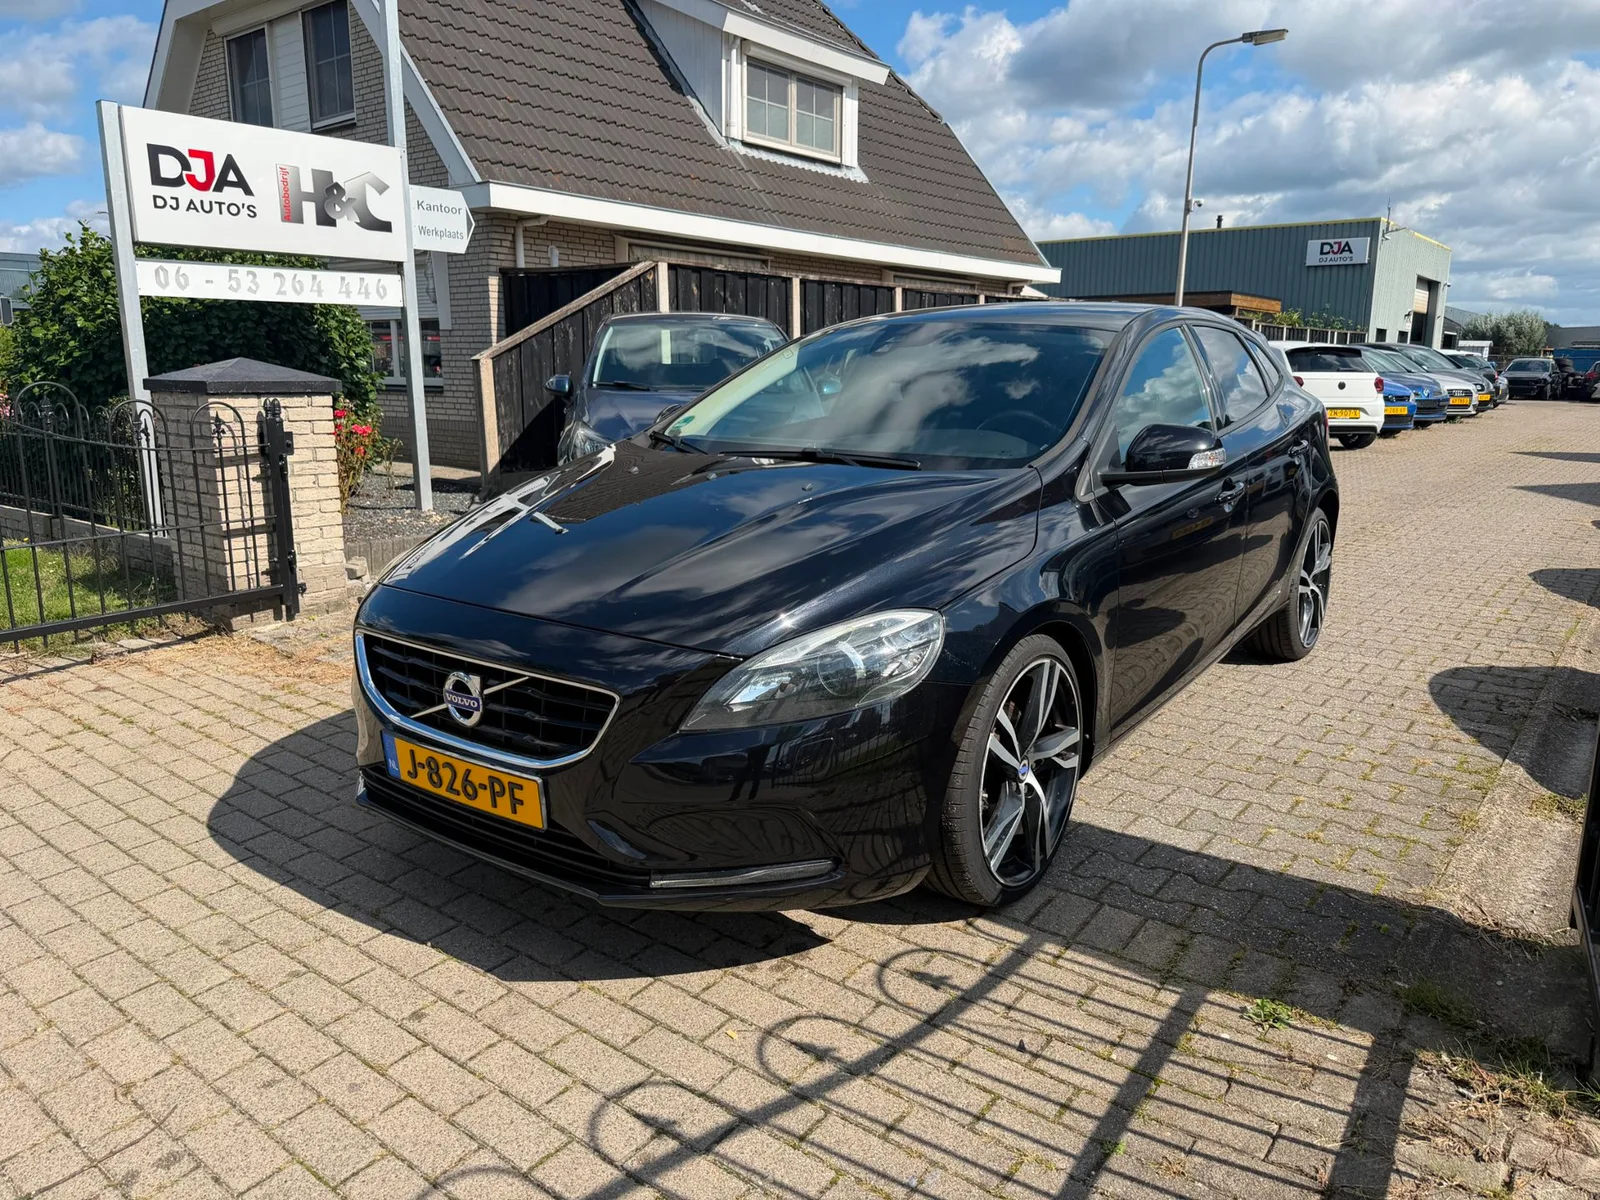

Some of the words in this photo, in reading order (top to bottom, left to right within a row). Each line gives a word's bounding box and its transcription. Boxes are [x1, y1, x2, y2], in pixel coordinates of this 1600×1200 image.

[146, 143, 255, 197] DJA
[276, 164, 392, 233] H&C
[279, 166, 292, 221] Autobedrijf
[152, 194, 180, 211] DJ
[186, 198, 258, 218] AUTO'S
[416, 199, 463, 215] Kantoor
[417, 225, 464, 240] Werkplaats
[1319, 240, 1353, 255] DJA
[154, 264, 190, 291] 06
[228, 268, 260, 295] 53
[273, 272, 325, 298] 264
[338, 275, 388, 300] 446
[445, 693, 478, 708] VOLVO
[388, 758, 399, 770] NL
[407, 749, 524, 815] J-826-PF
